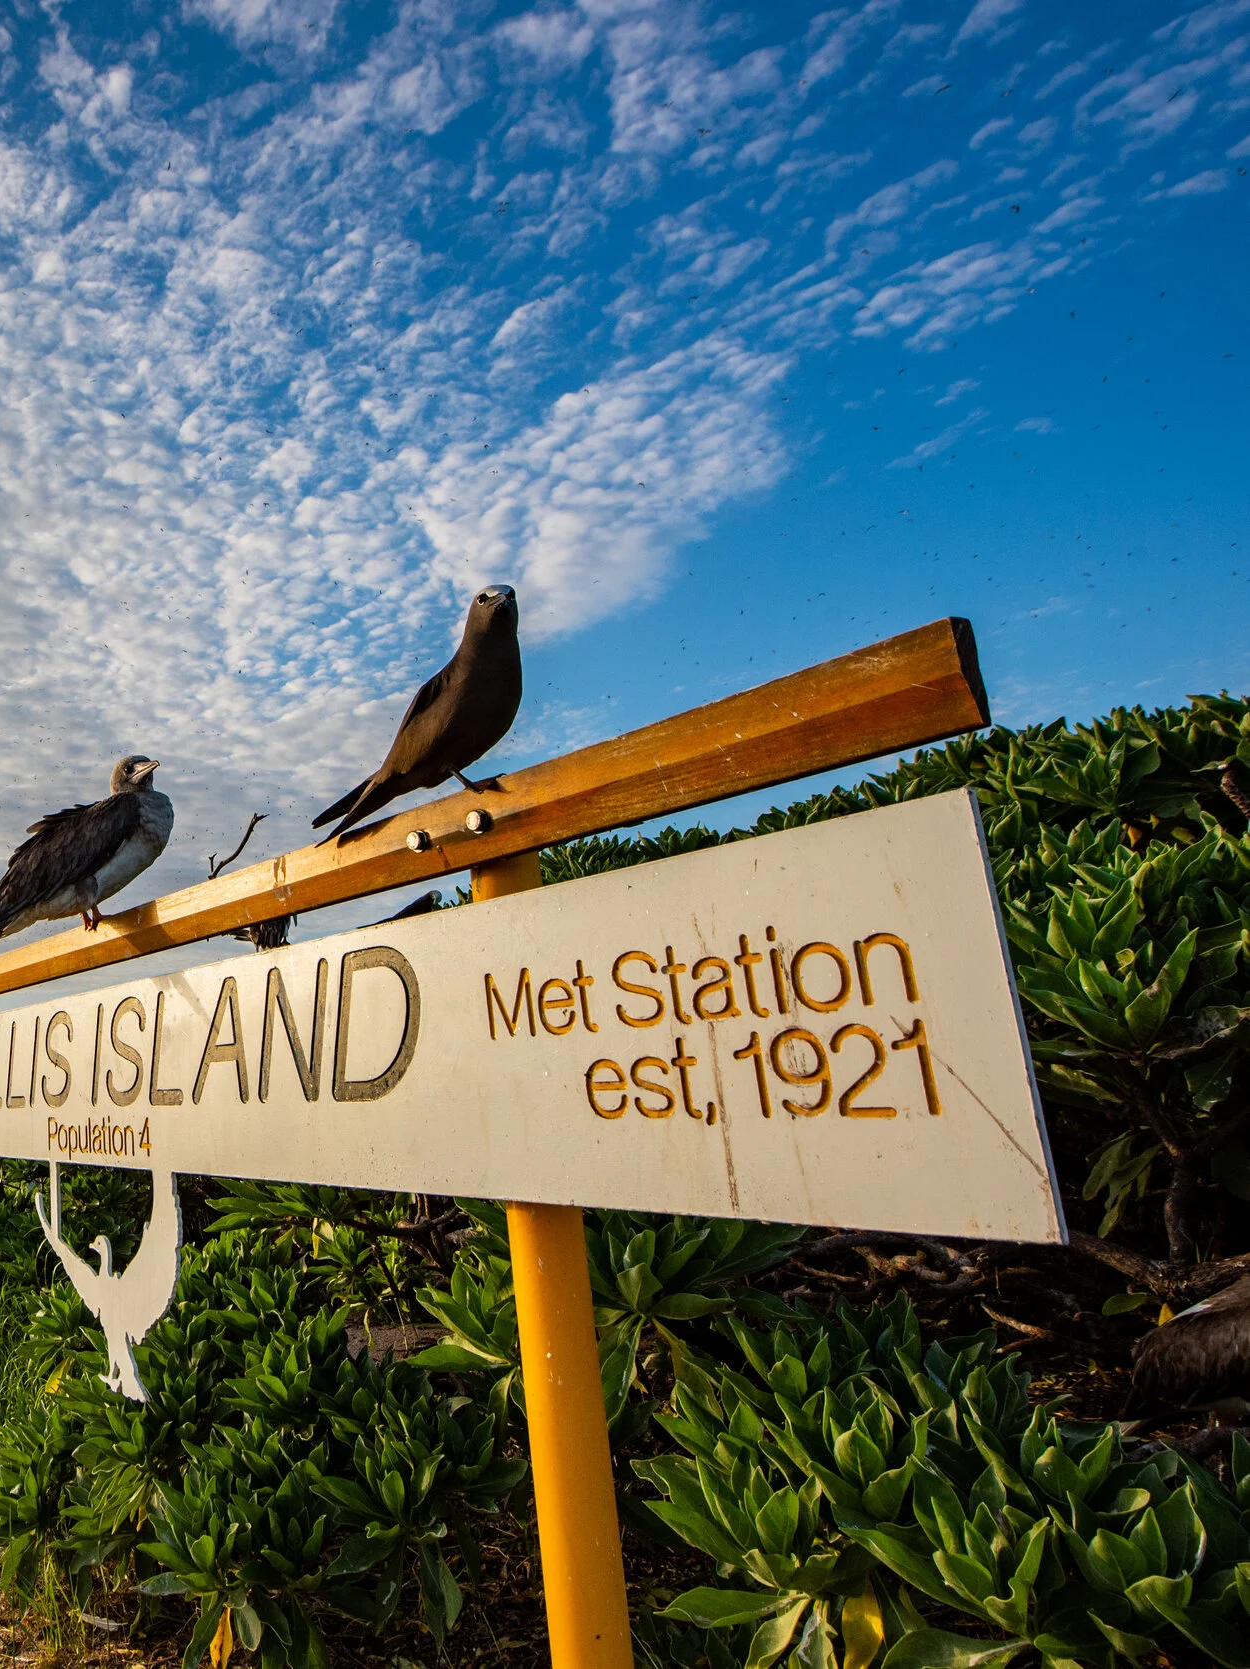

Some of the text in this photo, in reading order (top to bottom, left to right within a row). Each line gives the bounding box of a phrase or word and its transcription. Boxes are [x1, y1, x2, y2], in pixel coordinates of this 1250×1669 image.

[91, 945, 421, 1108] ISLAND
[484, 926, 919, 1040] Met Station
[733, 1018, 942, 1119] 1921
[48, 1116, 152, 1160] Population 4
